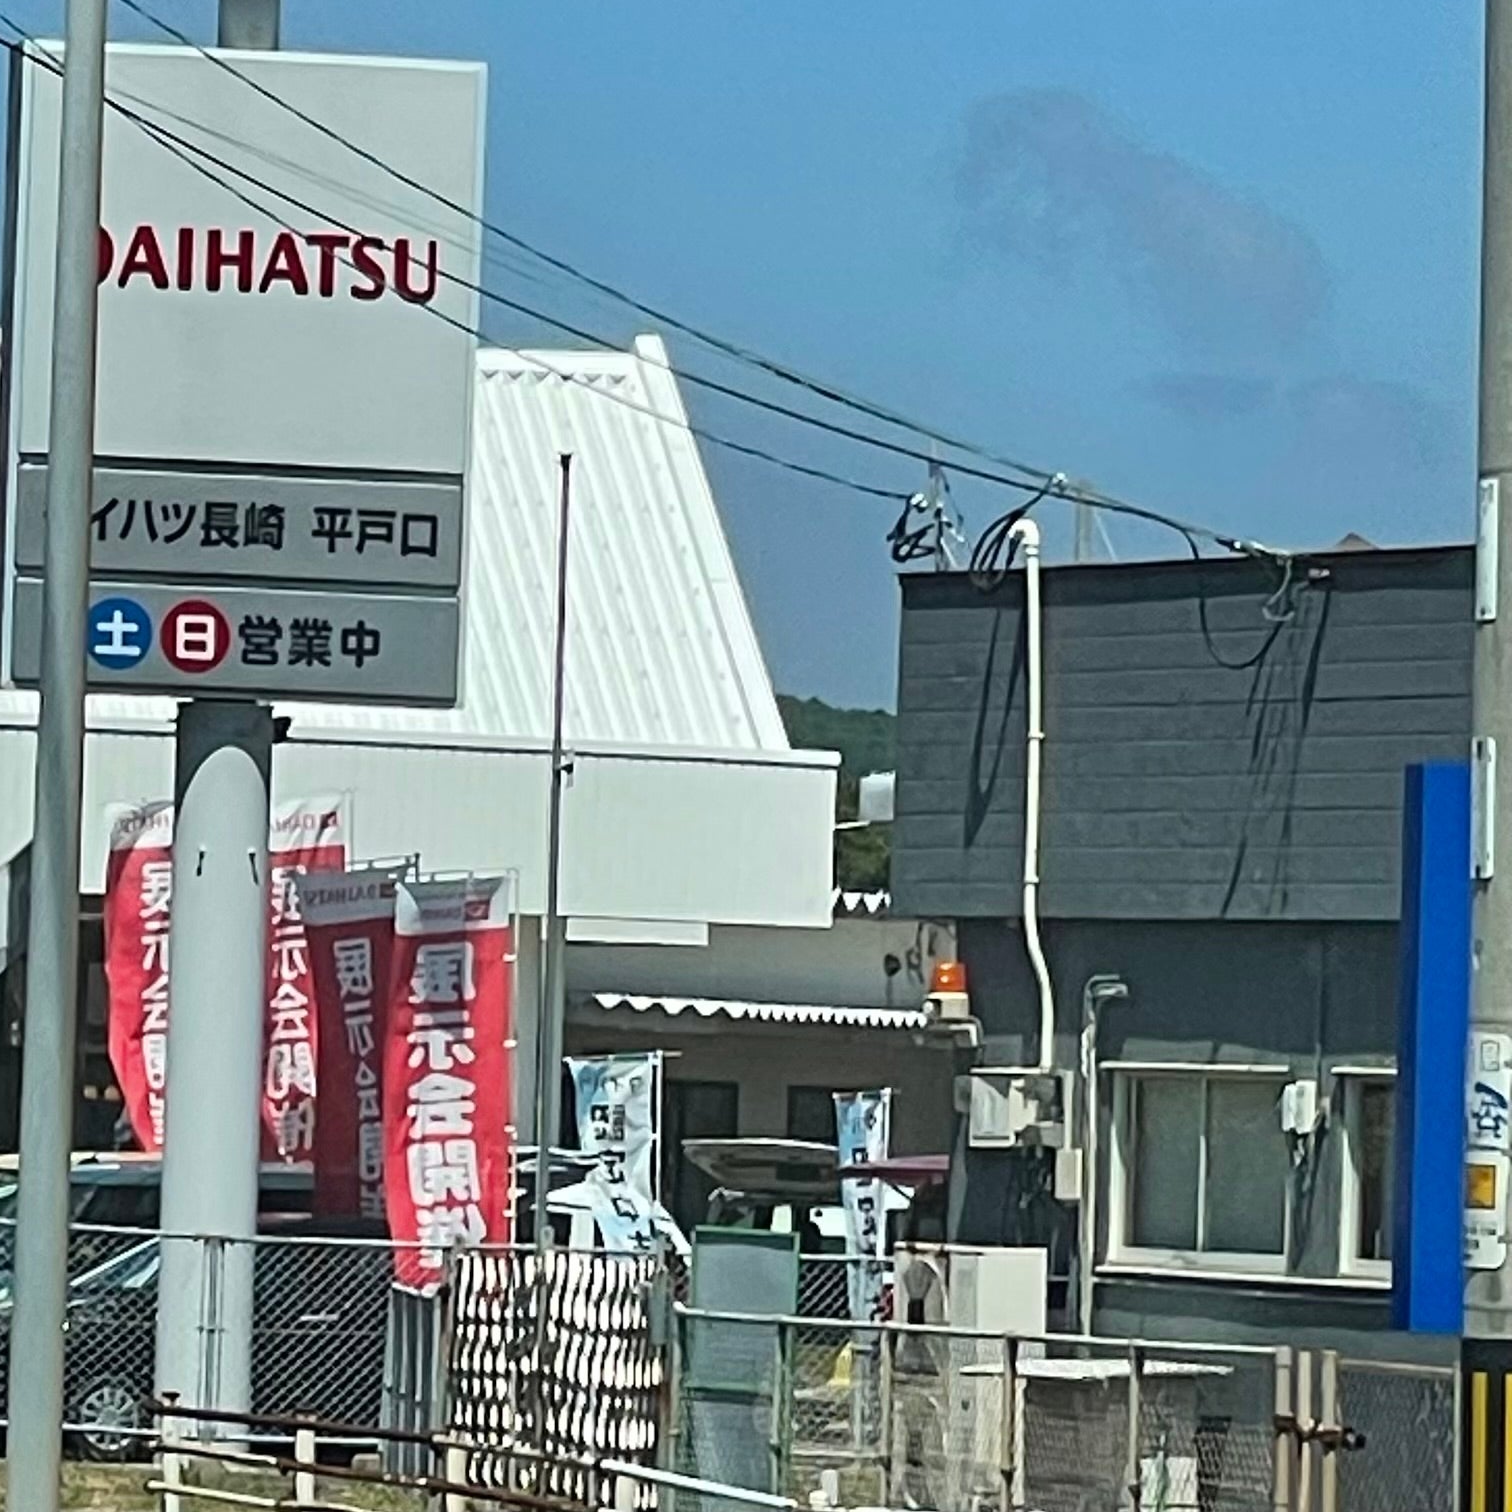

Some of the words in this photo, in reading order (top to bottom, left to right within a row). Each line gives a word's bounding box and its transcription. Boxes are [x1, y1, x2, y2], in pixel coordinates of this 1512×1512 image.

[91, 498, 285, 550] イハツ長崎
[311, 506, 438, 557] 平戸口
